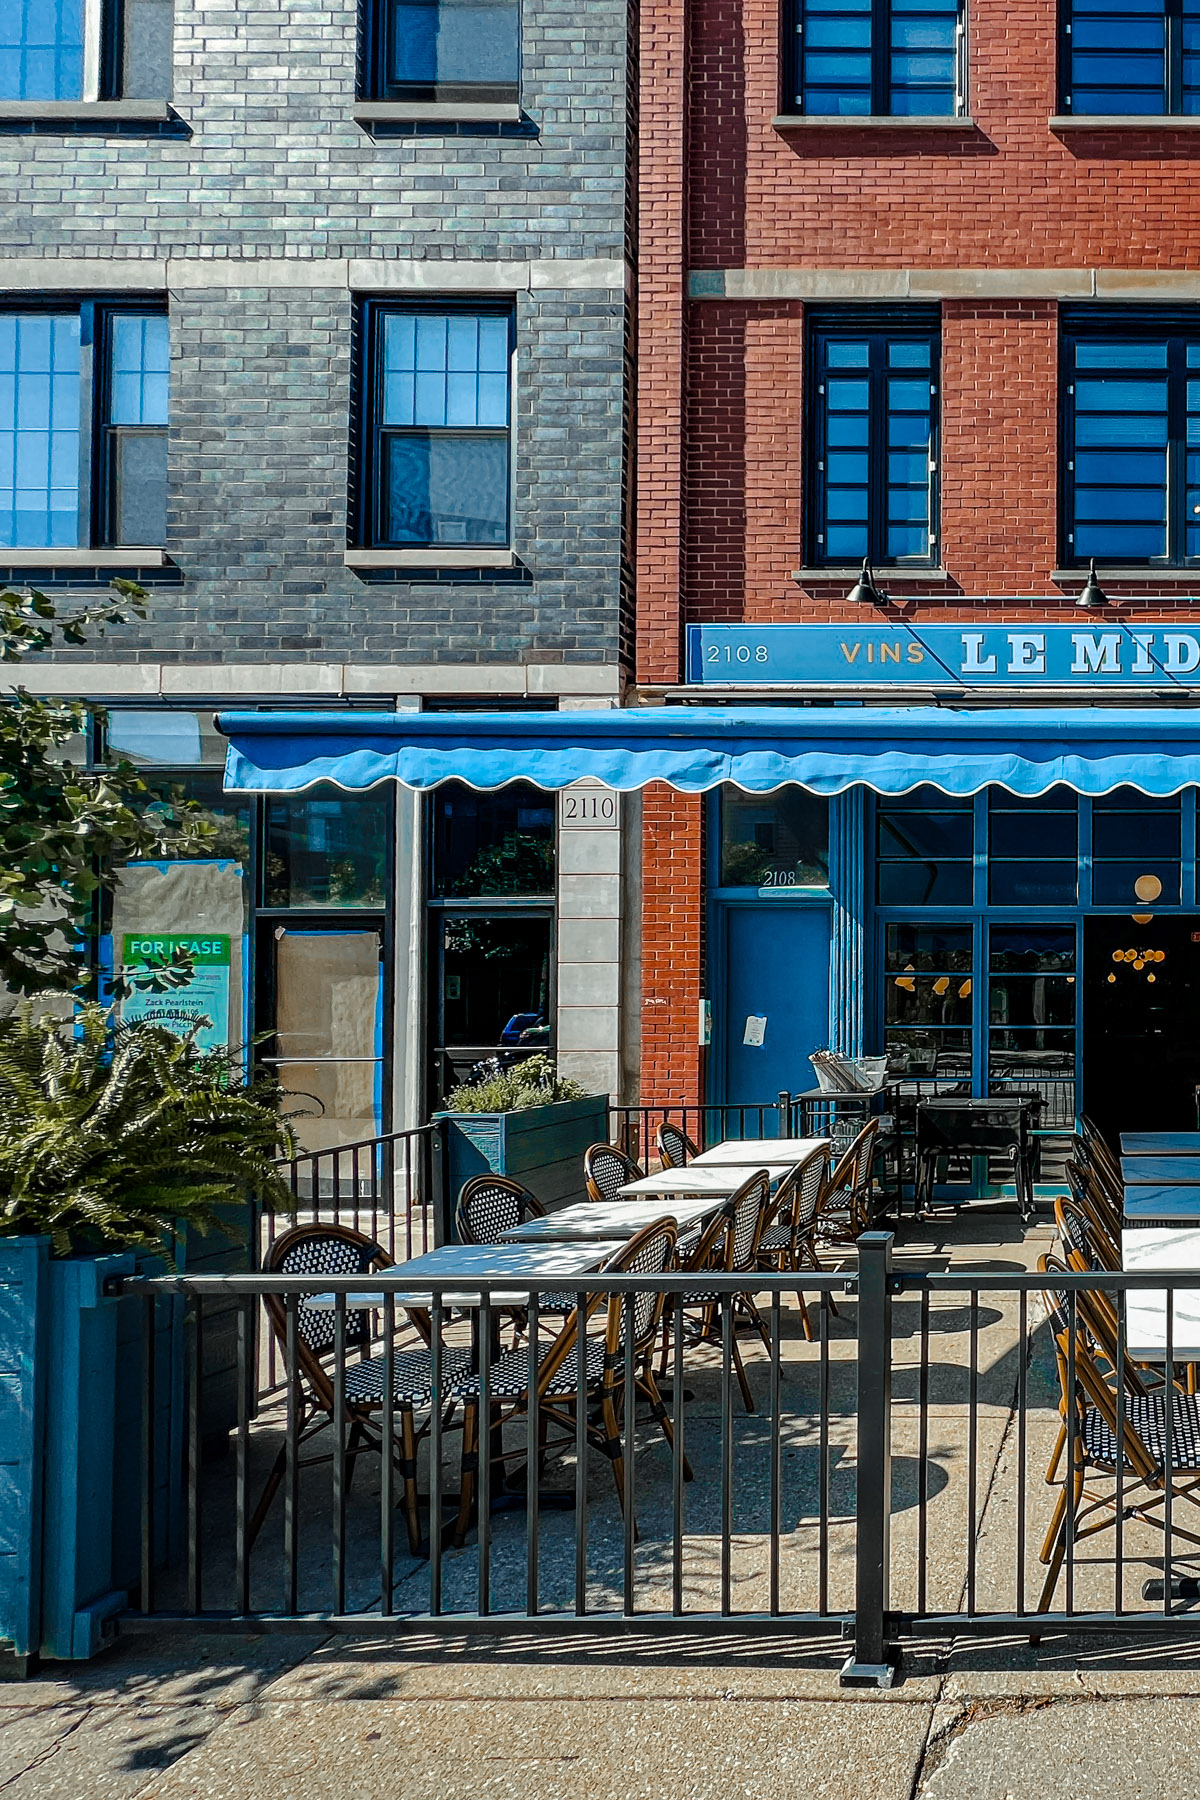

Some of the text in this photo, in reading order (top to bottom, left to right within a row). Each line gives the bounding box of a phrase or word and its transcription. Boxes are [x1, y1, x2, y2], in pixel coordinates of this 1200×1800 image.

[707, 645, 769, 663] 2108
[840, 642, 926, 665] VINS
[960, 633, 1047, 674] LE
[565, 797, 614, 819] 2110
[763, 871, 796, 886] 2108
[130, 941, 165, 955] FOR
[145, 998, 204, 1006] Zack Pearlstein
